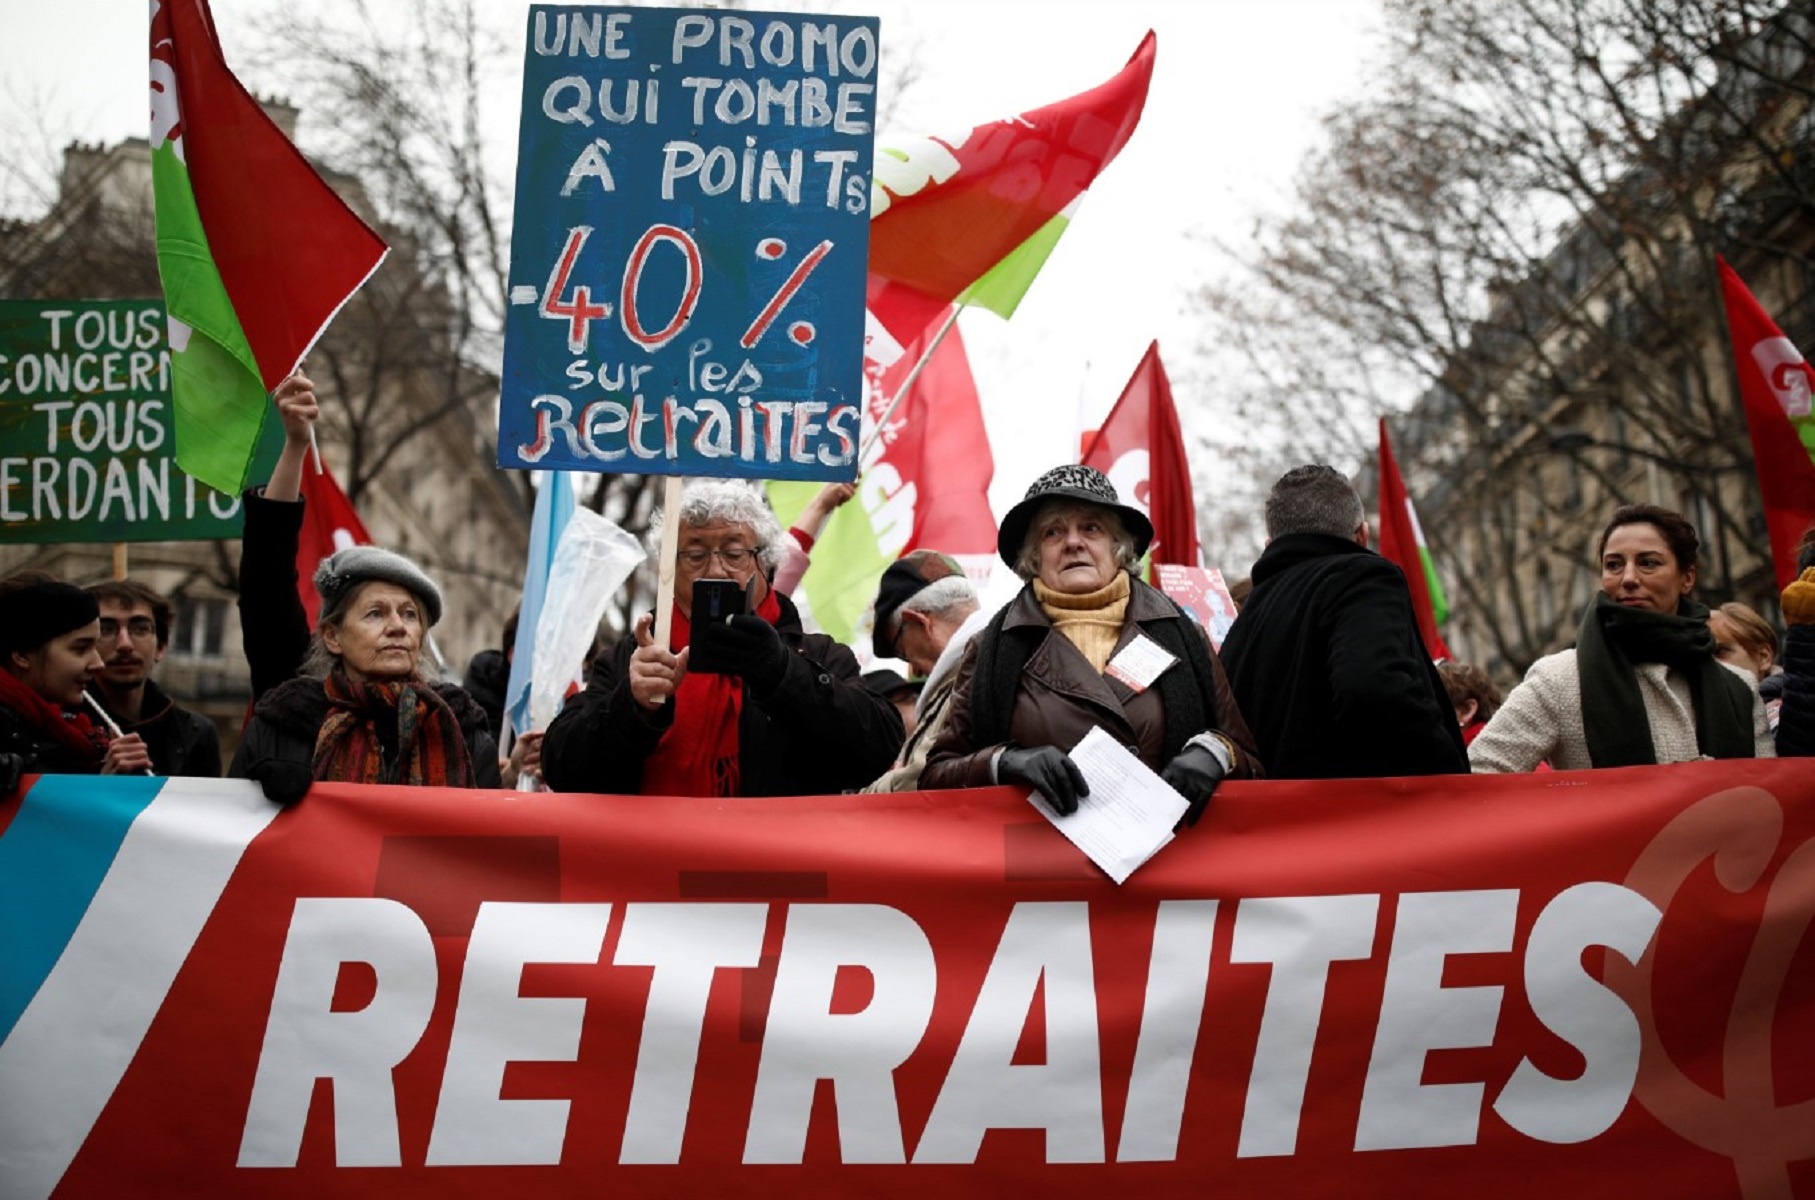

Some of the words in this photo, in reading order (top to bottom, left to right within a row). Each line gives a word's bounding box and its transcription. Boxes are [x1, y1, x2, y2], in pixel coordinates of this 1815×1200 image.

[534, 10, 632, 60] UNE
[672, 14, 876, 79] PROMO
[681, 76, 874, 134] TOMBE
[510, 223, 703, 355] -40
[40, 308, 161, 351] TOUS
[565, 358, 654, 392] sur
[688, 337, 764, 394] les
[33, 399, 165, 454] TOUS
[236, 881, 1663, 1167] RETRAITES
